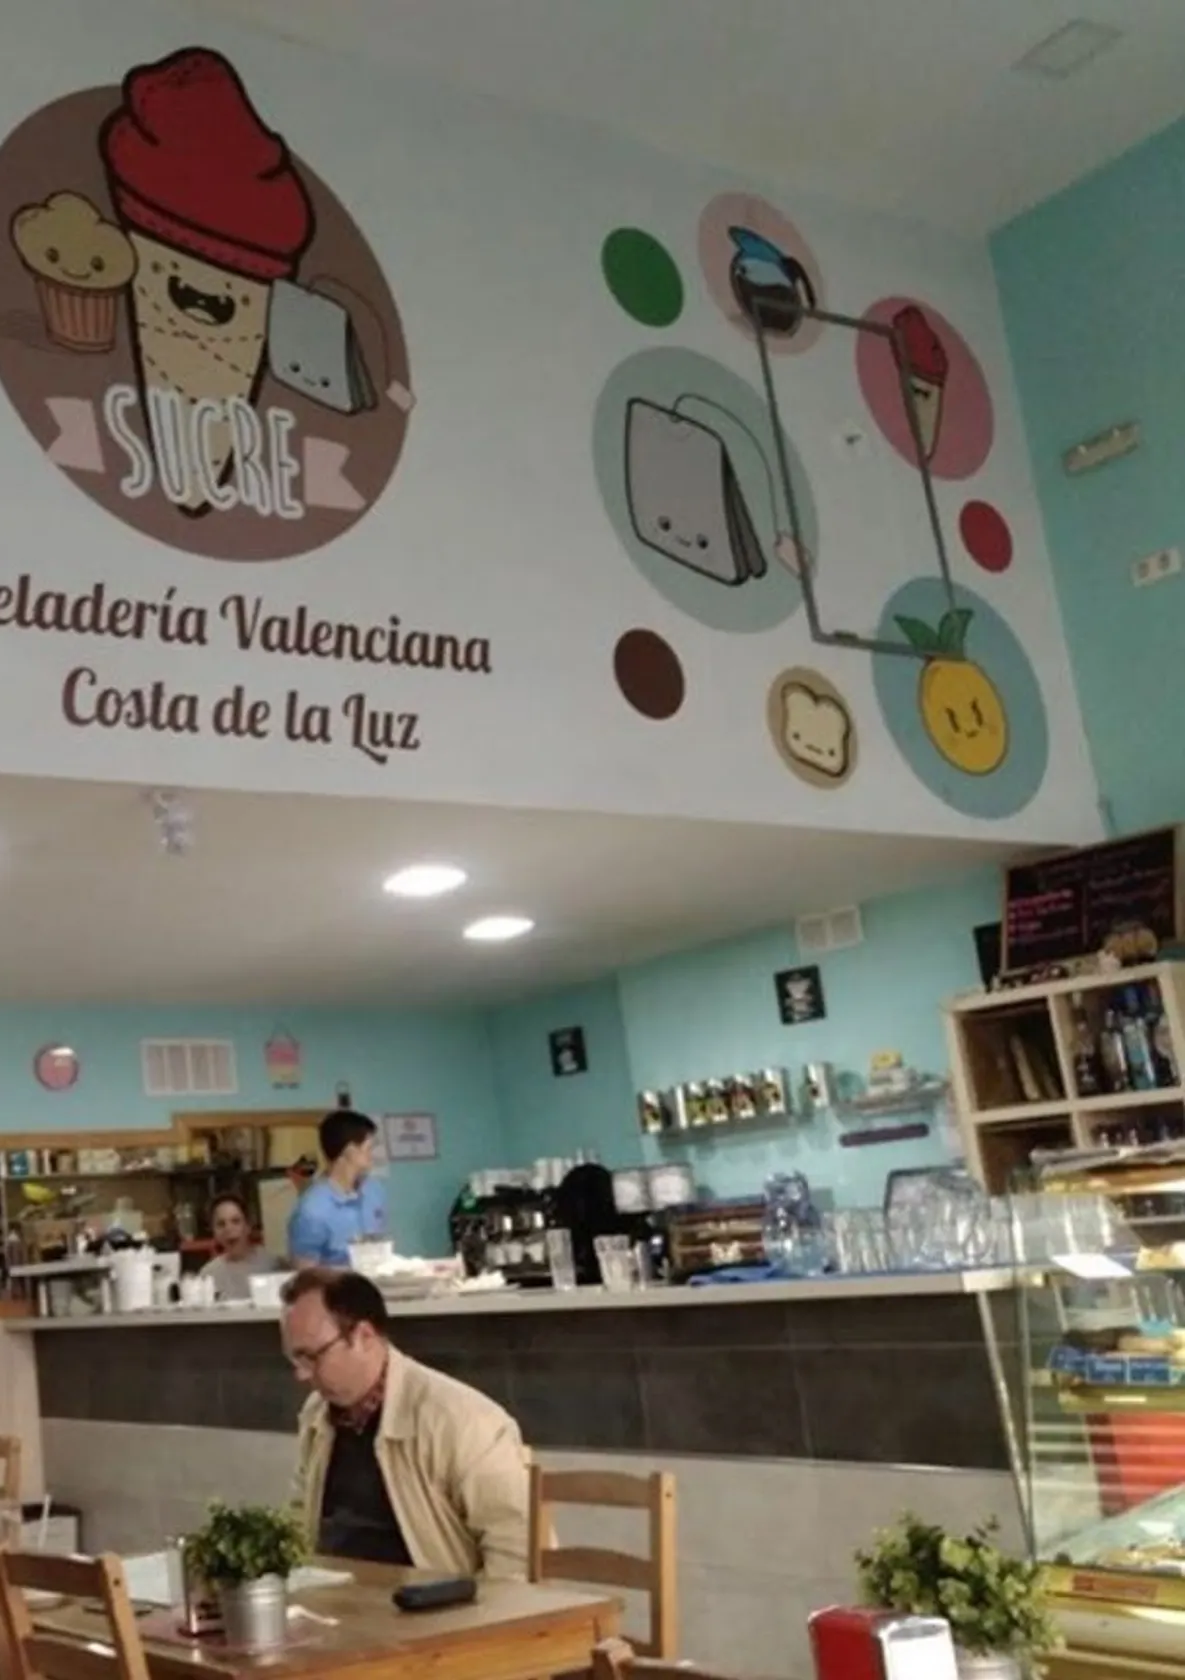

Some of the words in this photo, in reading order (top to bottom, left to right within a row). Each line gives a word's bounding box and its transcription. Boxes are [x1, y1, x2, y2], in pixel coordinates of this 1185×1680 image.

[104, 383, 305, 519] SUCRE
[220, 594, 493, 673] Valenciana
[62, 667, 198, 734] Costa
[212, 683, 270, 740] de
[285, 690, 331, 743] la
[343, 693, 421, 764] Luz
